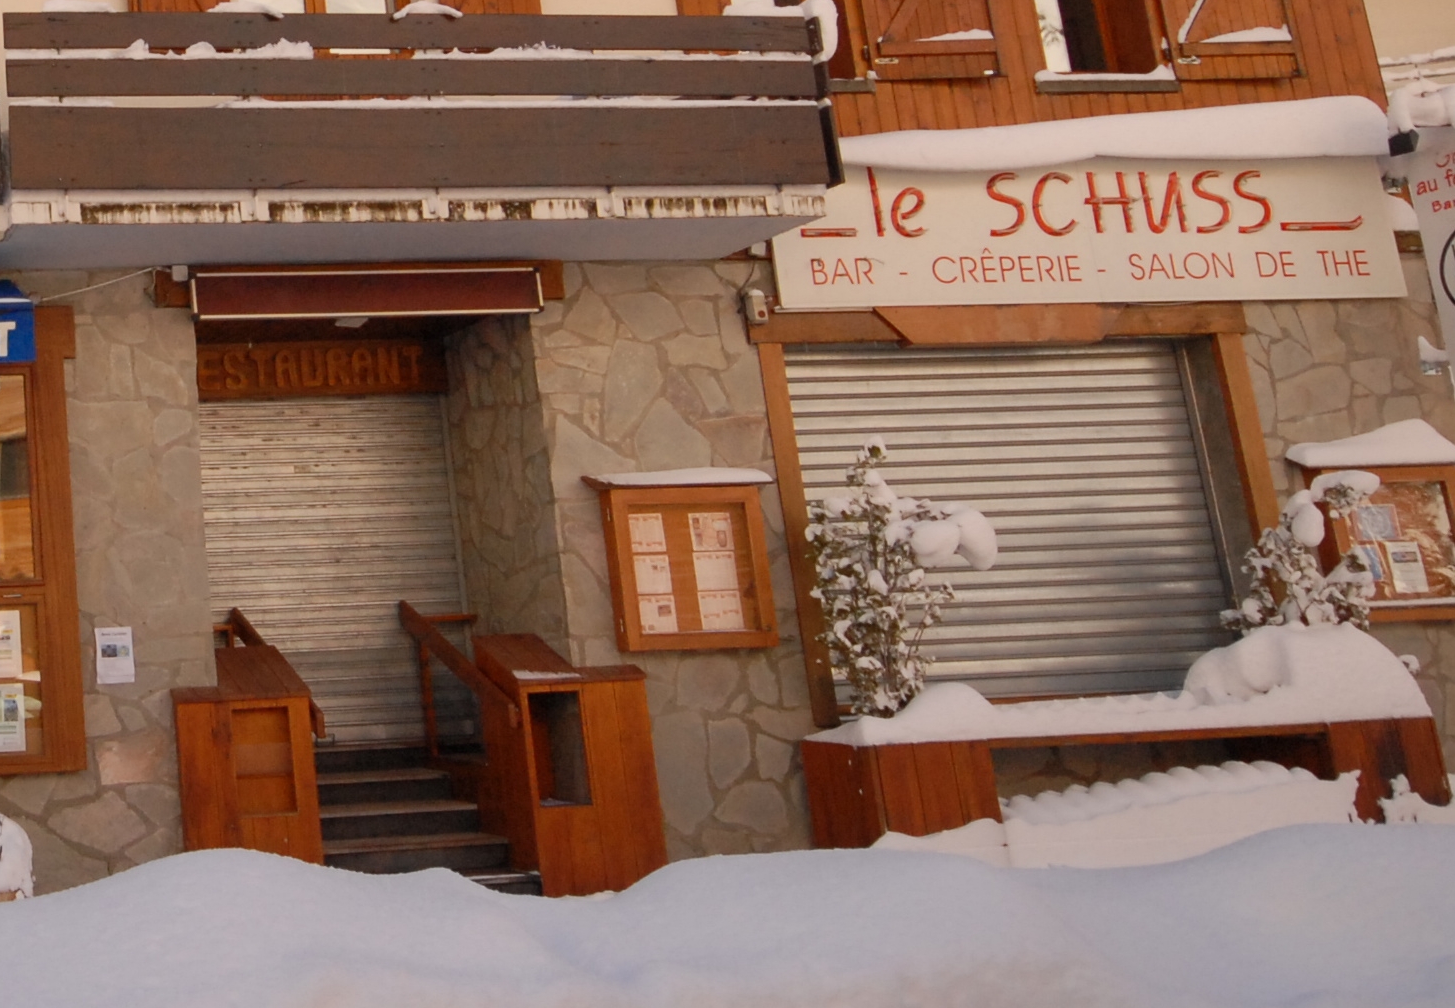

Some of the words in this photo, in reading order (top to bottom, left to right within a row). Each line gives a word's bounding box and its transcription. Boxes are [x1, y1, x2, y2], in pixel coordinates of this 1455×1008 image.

[865, 165, 927, 239] le
[983, 168, 1274, 239] SCHUSS
[1416, 178, 1438, 196] au
[809, 255, 875, 287] BAR
[931, 246, 1083, 285] CRÊPERIE
[1127, 250, 1236, 282] SALON
[1253, 249, 1298, 279] DE
[1315, 248, 1372, 278] THE
[197, 346, 424, 391] ESTAURANT
